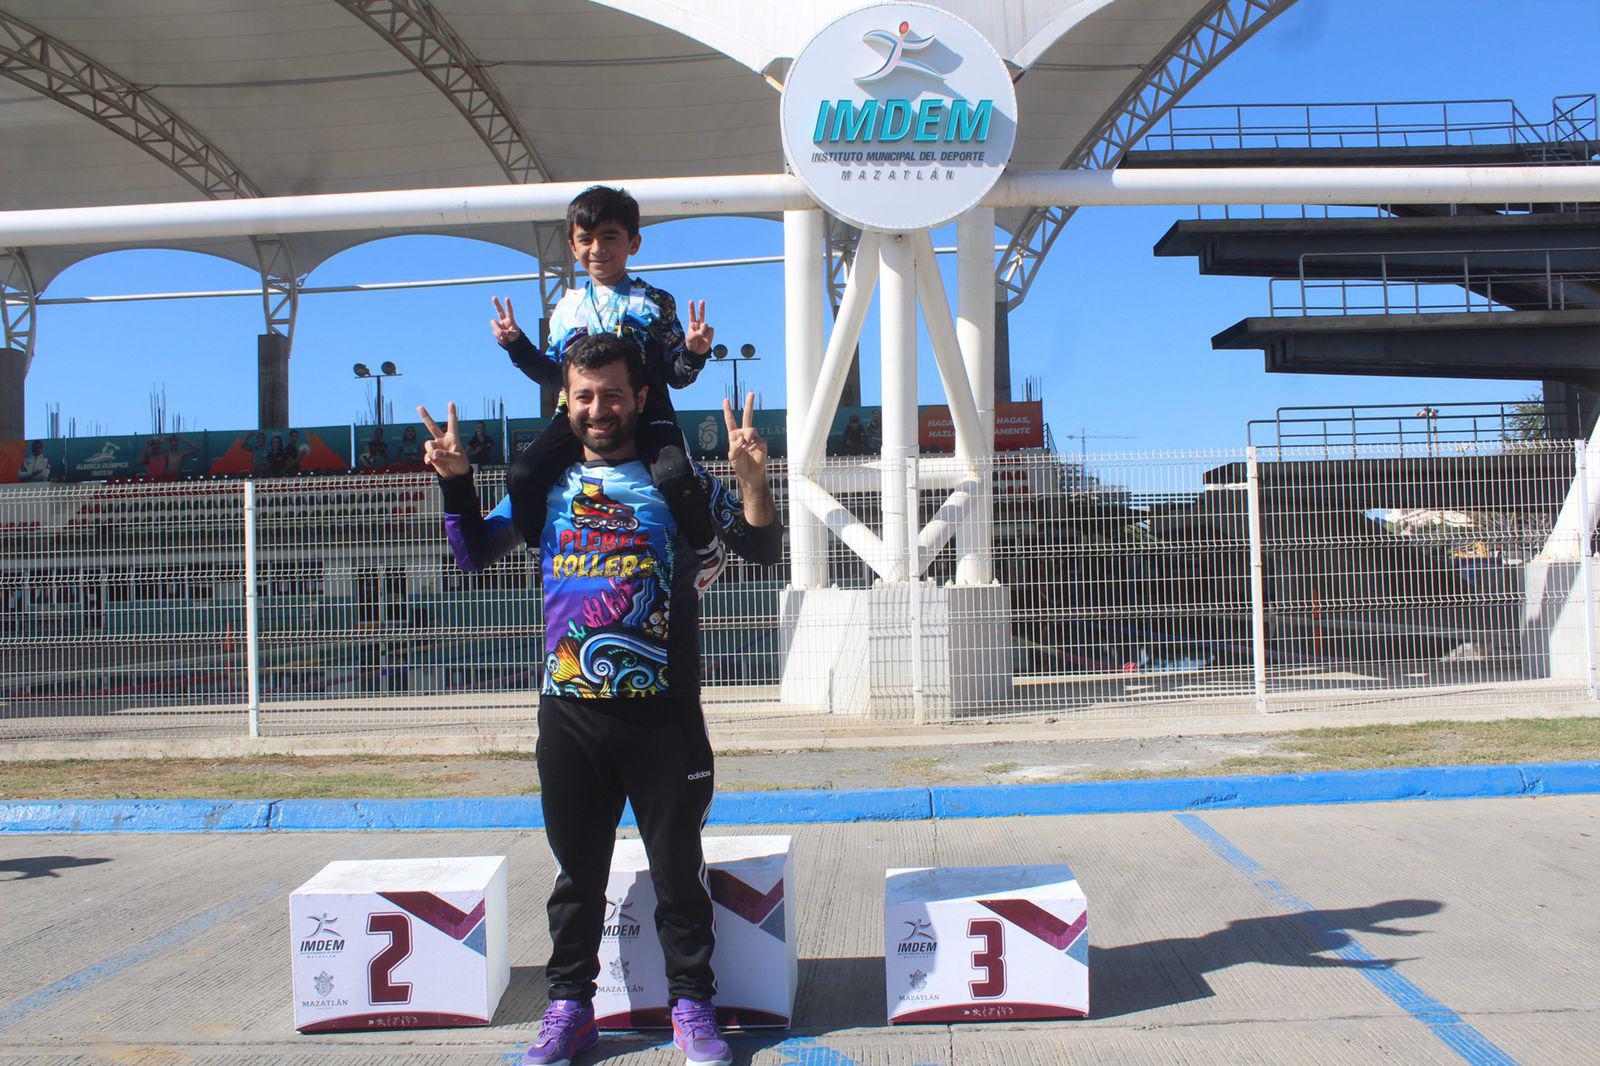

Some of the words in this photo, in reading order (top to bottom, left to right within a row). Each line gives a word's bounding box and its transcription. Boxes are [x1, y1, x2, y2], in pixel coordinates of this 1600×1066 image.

[813, 99, 994, 143] IMDEM
[811, 151, 863, 163] INSTITUTO
[866, 151, 916, 162] MUNICIPAL
[919, 151, 937, 162] DEL
[940, 151, 985, 162] DEPORTE
[841, 167, 955, 182] MAZATLÁN
[928, 419, 954, 428] HAGA
[928, 430, 956, 438] HAZL
[994, 427, 1032, 435] AMENTE
[560, 529, 650, 554] PLEBES
[687, 770, 712, 781] adidas
[602, 925, 640, 936] MDEM
[300, 939, 345, 951] IMDEM
[897, 942, 937, 952] IMDEM
[366, 912, 414, 1006] 2
[967, 918, 1008, 1000] 3
[597, 984, 644, 993] MAZATLÁN
[302, 998, 348, 1008] MAZATLÁN
